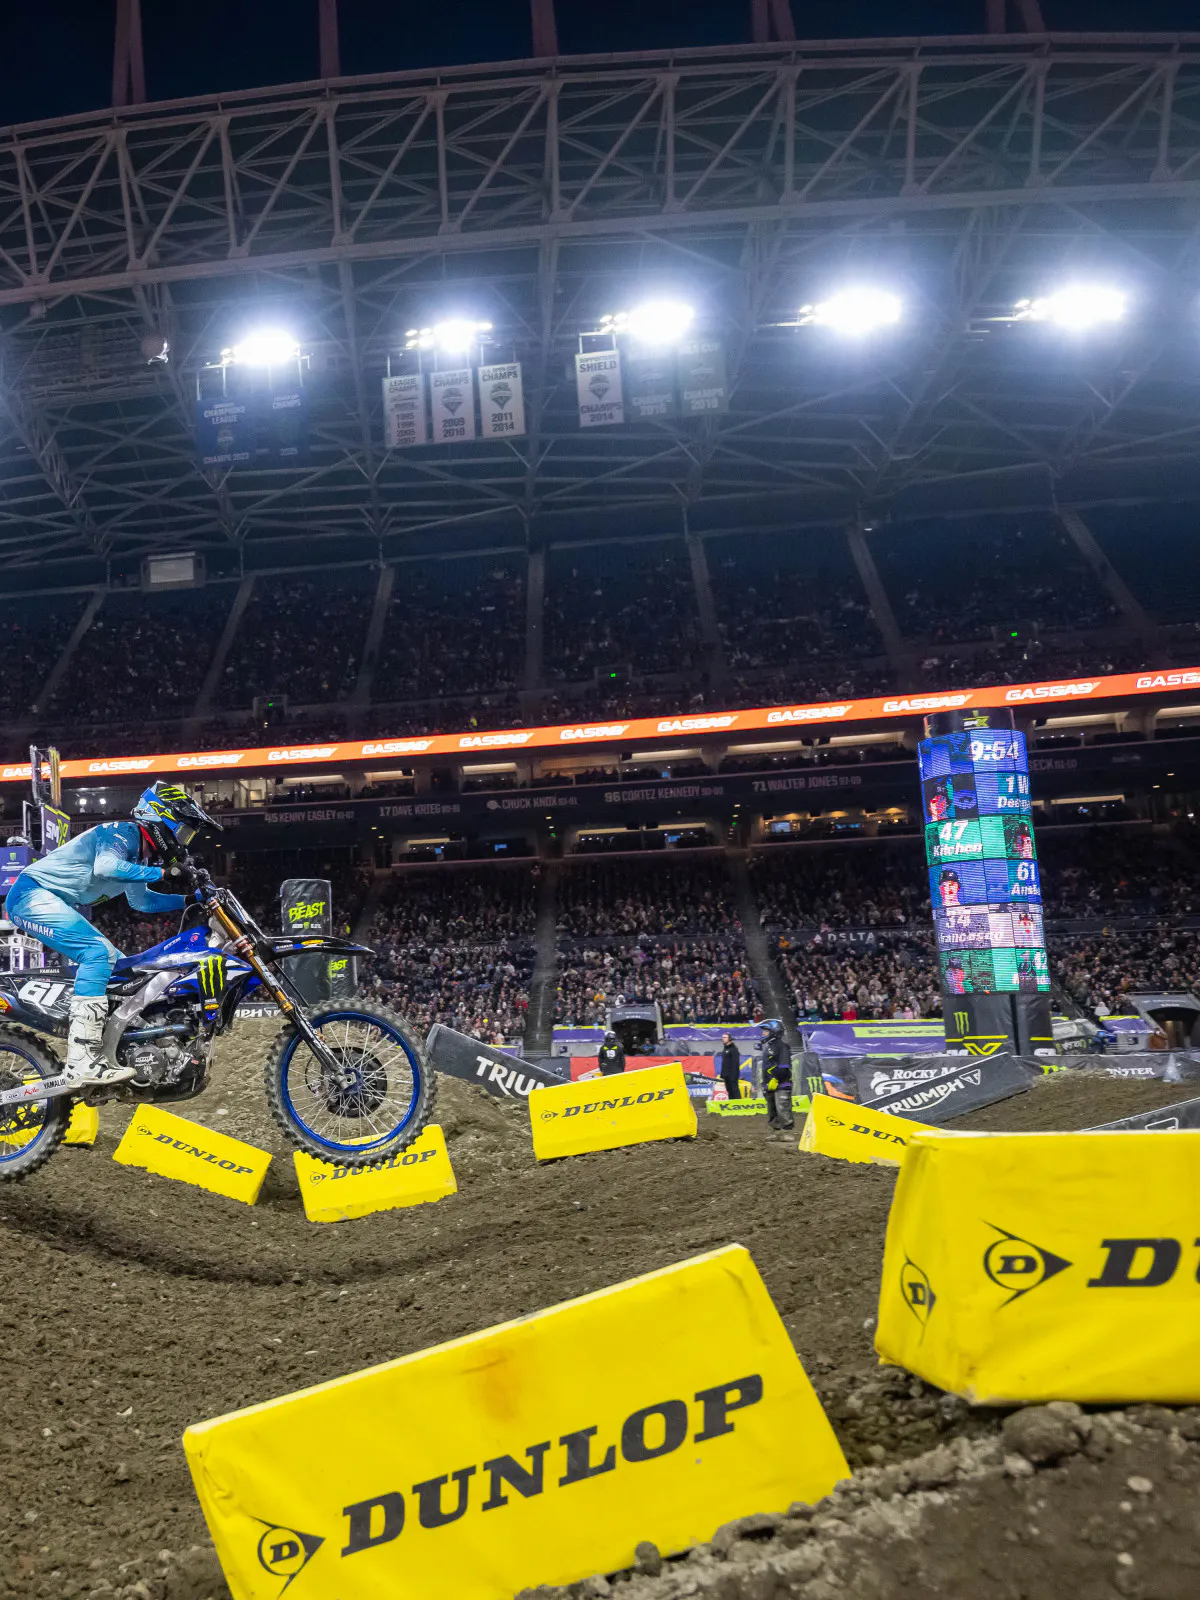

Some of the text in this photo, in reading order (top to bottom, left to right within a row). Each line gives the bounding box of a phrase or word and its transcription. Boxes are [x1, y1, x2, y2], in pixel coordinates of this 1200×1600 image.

[580, 361, 617, 373] SHIELD
[435, 377, 470, 387] CHAMPS
[482, 371, 518, 381] CHAMPS
[204, 405, 246, 418] CHAMPIONS
[492, 412, 513, 422] 2011
[211, 415, 238, 425] LEAGUE
[493, 422, 514, 432] 2014
[1136, 673, 1200, 688] GASG
[1006, 682, 1100, 700] GASGAS
[883, 695, 972, 712] GASGAS
[768, 705, 852, 722] GASGAS
[658, 716, 738, 732] GASGAS
[560, 725, 629, 739] GASGAS
[362, 741, 435, 754] GASGAS
[459, 733, 533, 747] GASGAS
[268, 748, 337, 760] GASGAS
[971, 741, 1019, 761] 9:54
[89, 760, 154, 772] GASGAS
[177, 754, 244, 767] GASGAS
[752, 781, 767, 792] 71
[767, 778, 805, 790] WALTER
[808, 776, 838, 788] JONES
[604, 792, 621, 802] 96
[621, 789, 656, 801] CORTEZ
[658, 786, 700, 798] KENNEDY
[379, 806, 390, 816] 17
[392, 805, 413, 816] DAVE
[415, 804, 440, 815] KRIEG
[502, 799, 531, 809] CHUCK
[533, 798, 558, 808] KNOX
[264, 813, 278, 823] 45
[279, 811, 305, 822] KENNY
[307, 810, 336, 821] EASLEY
[939, 819, 969, 841] 47
[933, 842, 983, 857] Kitchen
[1017, 861, 1036, 881] 61
[288, 902, 326, 923] BEAST
[22, 919, 54, 939] YAMAHA
[330, 959, 349, 971] EAST
[18, 980, 66, 1006] 61
[606, 1050, 616, 1058] 19
[475, 1056, 545, 1098] TRIU
[892, 1069, 938, 1080] ROCKY
[1105, 1067, 1156, 1077] NSTER
[562, 1088, 675, 1118] DUNLOP
[877, 1079, 965, 1115] TRIUMPH
[849, 1123, 908, 1147] DUN
[153, 1133, 254, 1175] DUNLOP
[1086, 1237, 1200, 1288] D
[341, 1373, 763, 1558] DUNLOP
